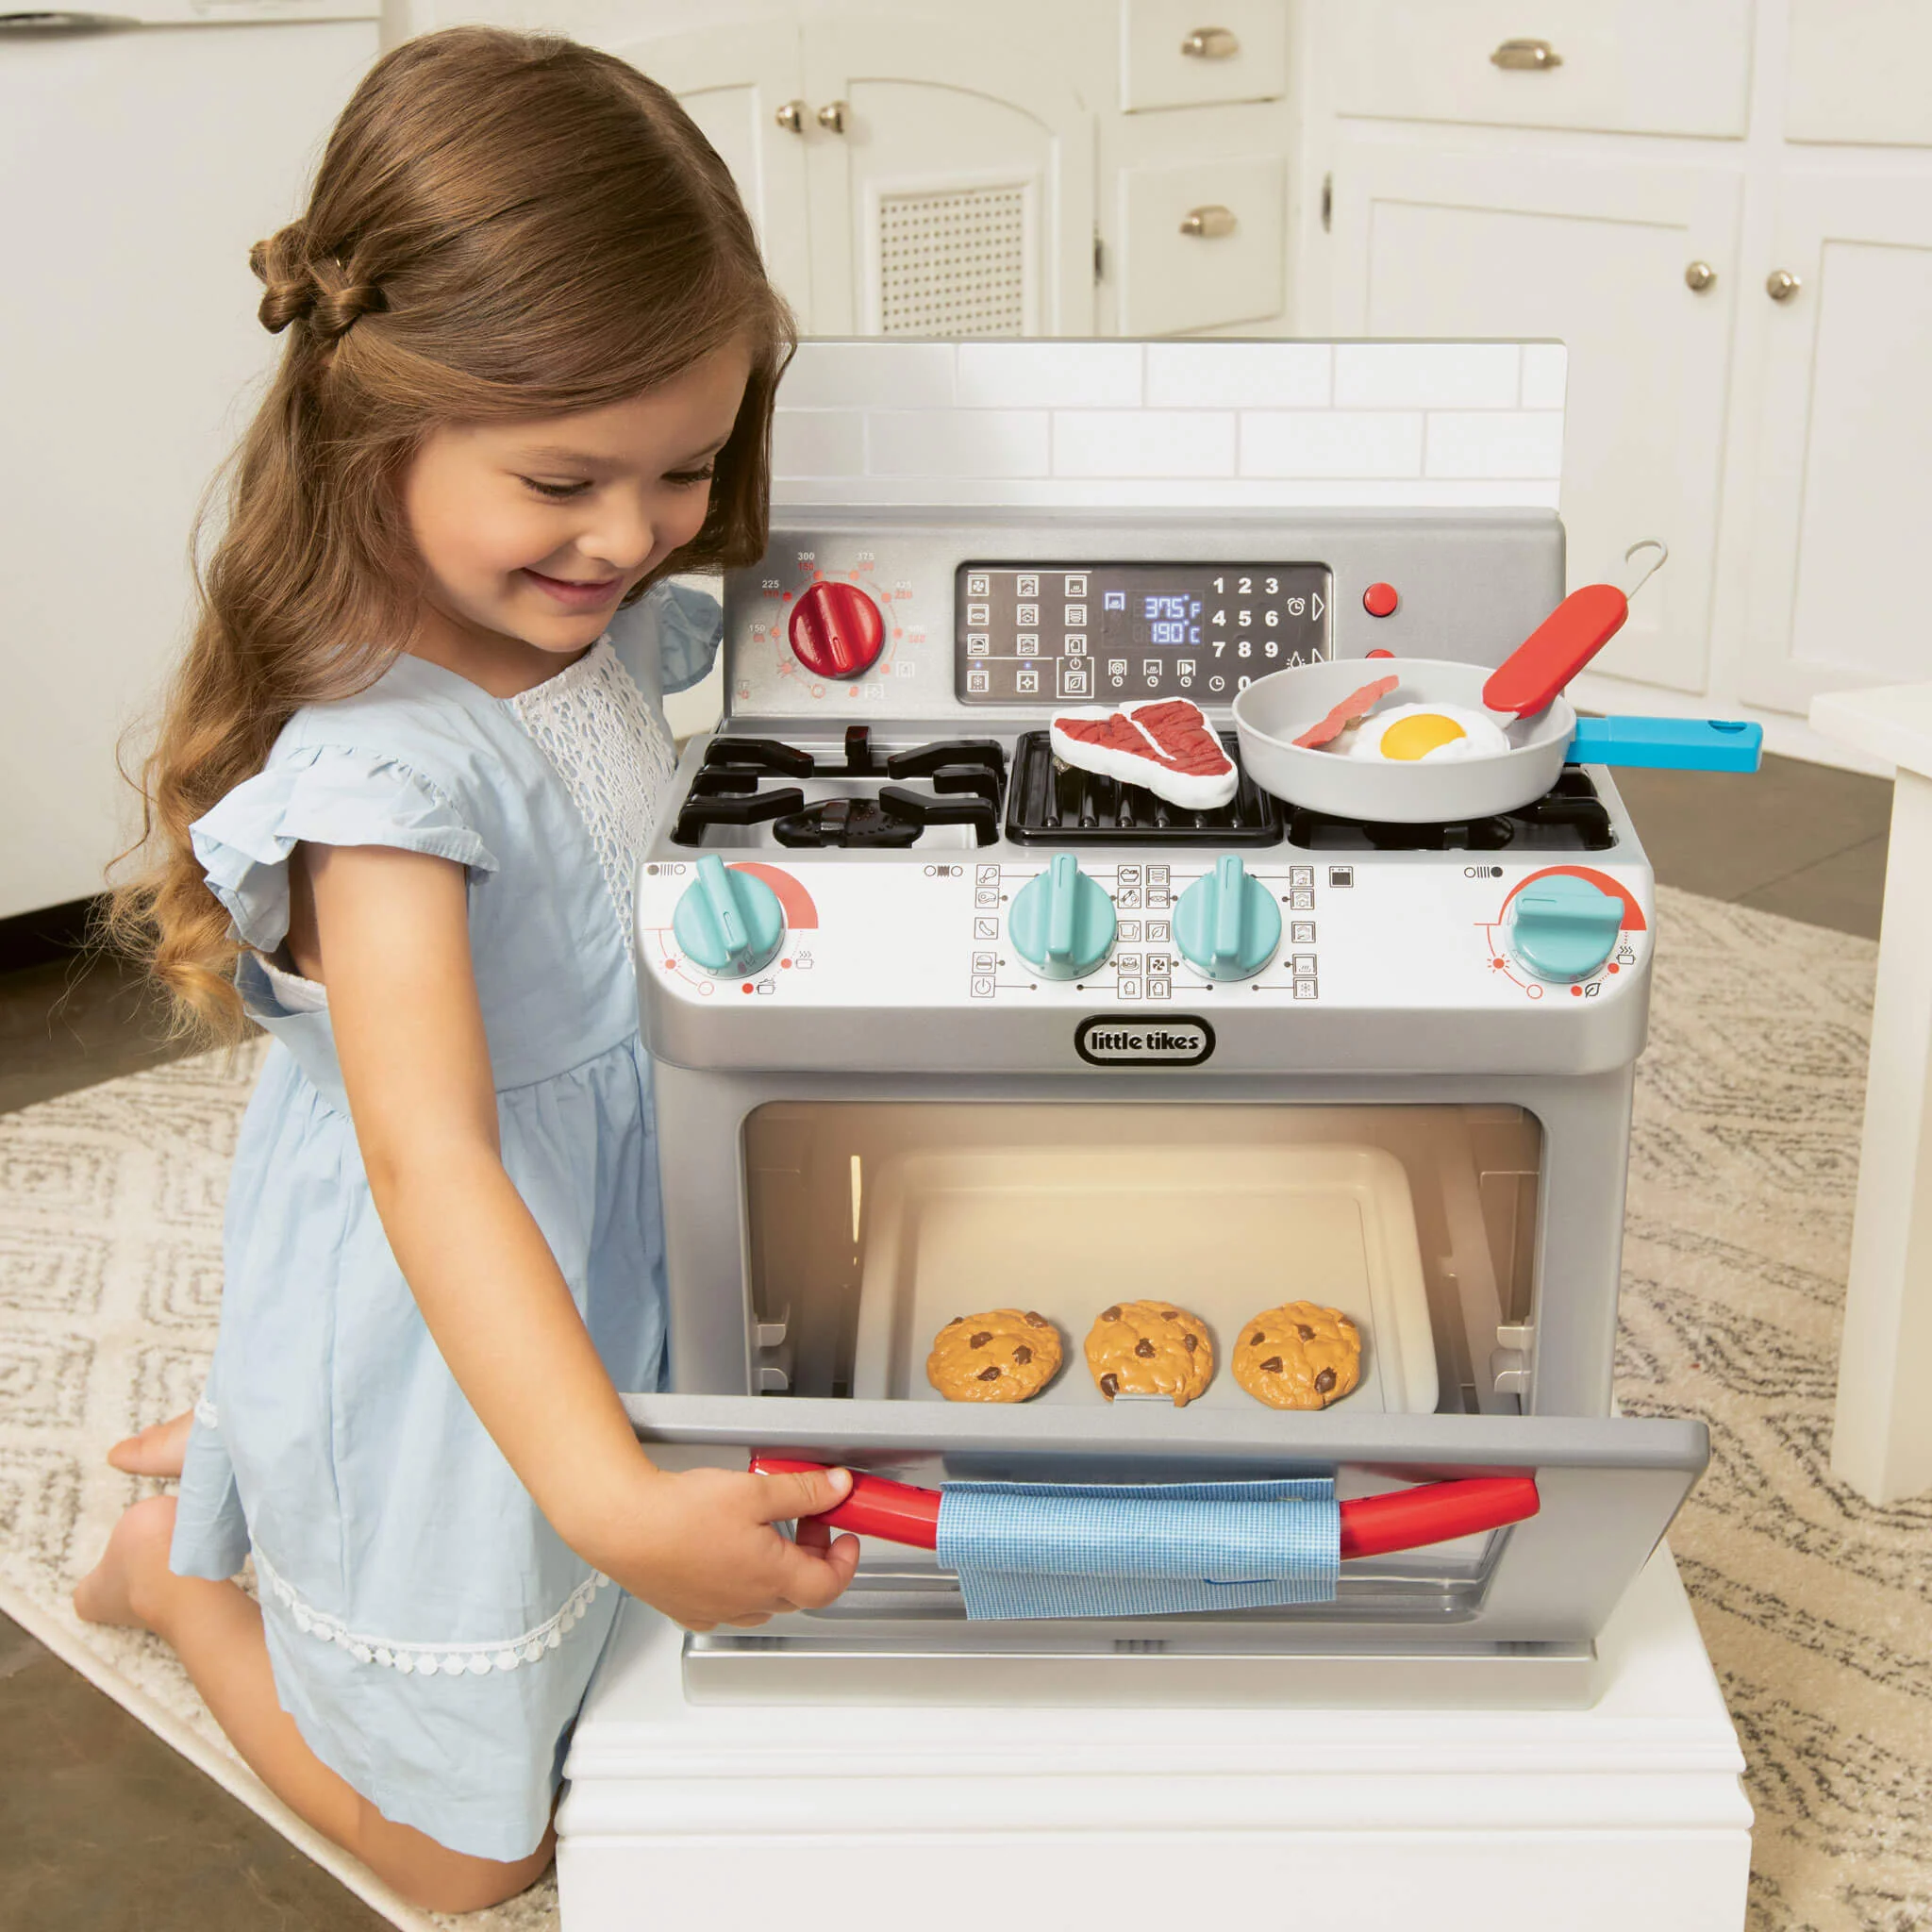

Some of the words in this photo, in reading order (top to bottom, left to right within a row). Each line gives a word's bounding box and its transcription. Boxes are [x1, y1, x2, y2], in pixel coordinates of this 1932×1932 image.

[797, 552, 815, 561] 300
[858, 552, 874, 561] 375
[761, 580, 779, 589] 225
[1213, 577, 1224, 593] 1
[1238, 577, 1252, 593] 2
[1265, 577, 1279, 593] 3
[1212, 610, 1226, 626] 4
[1238, 610, 1252, 626] 5
[1265, 610, 1278, 626] 6
[749, 624, 765, 632] 150
[1212, 641, 1226, 658] 7
[1238, 641, 1252, 658] 8
[1265, 641, 1278, 658] 9
[1238, 675, 1252, 691] 0
[1091, 1031, 1142, 1050] little
[1146, 1031, 1199, 1050] tikes
